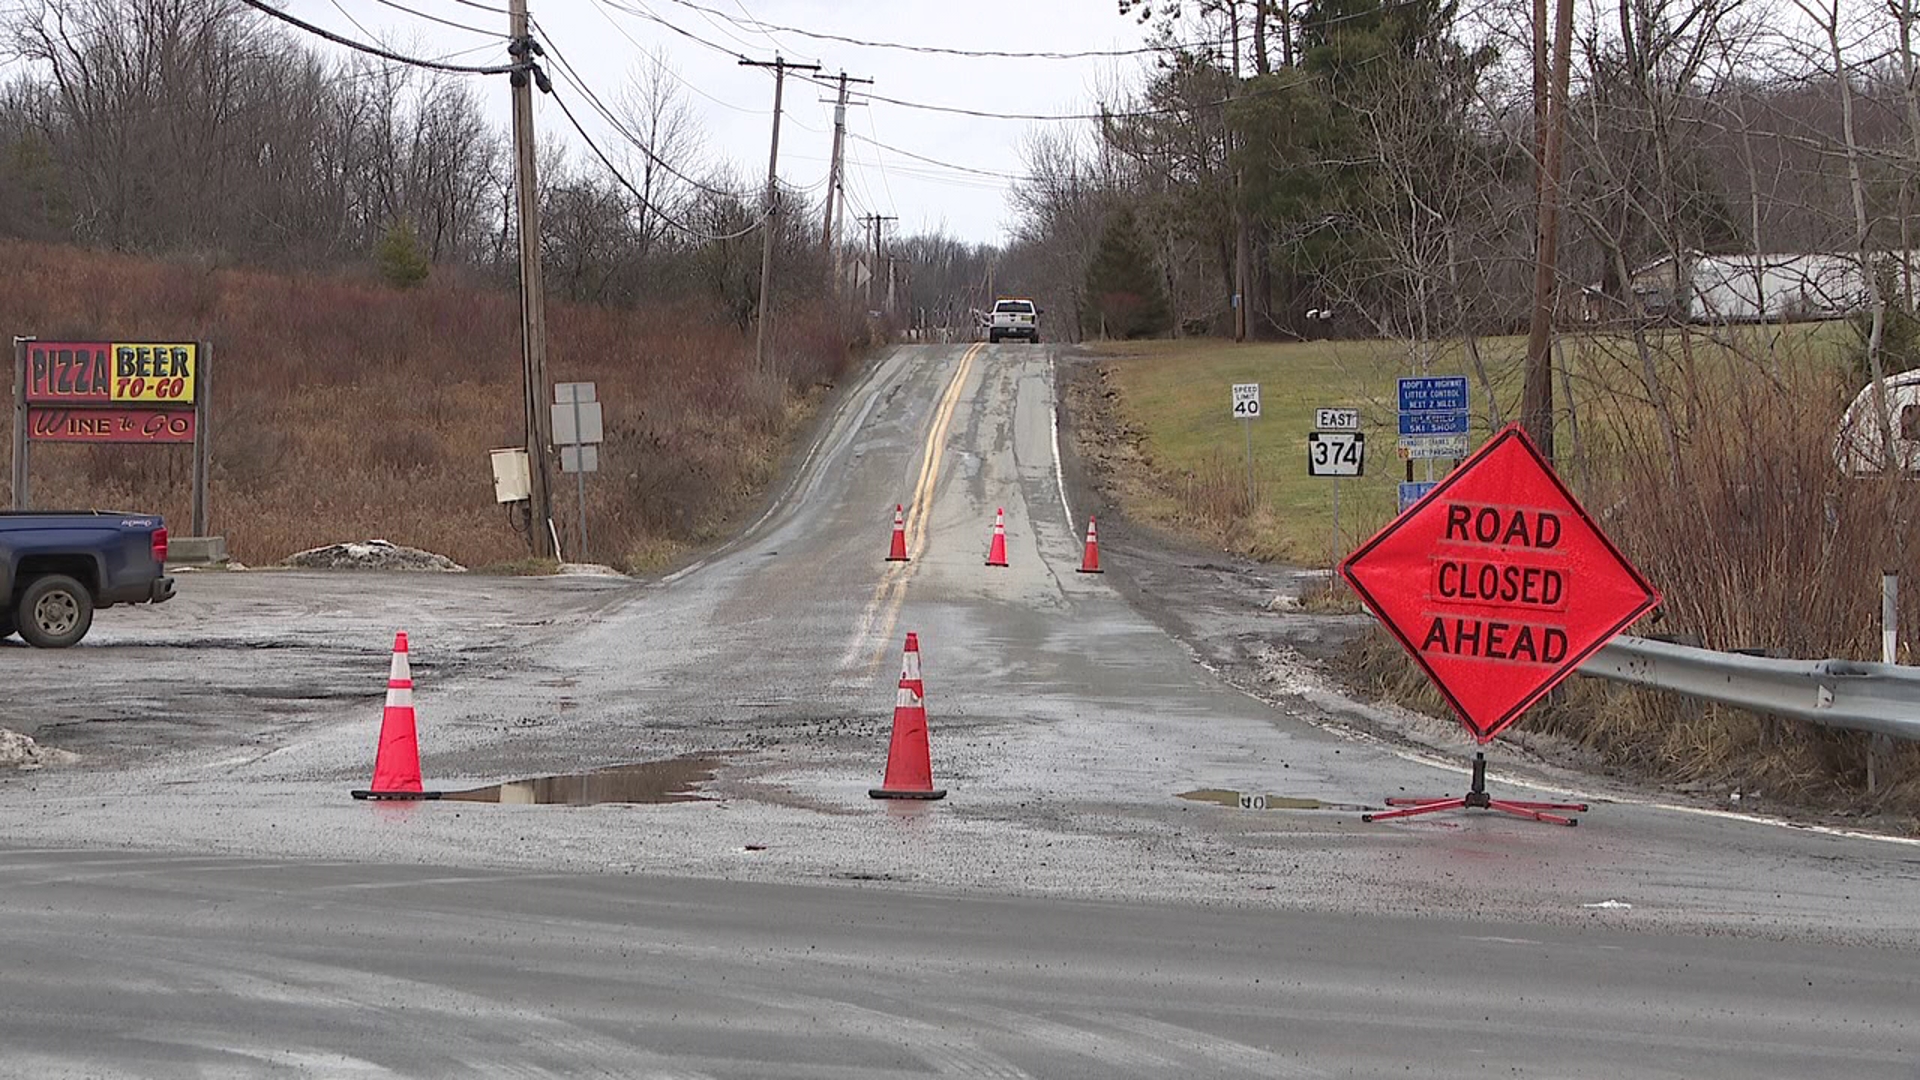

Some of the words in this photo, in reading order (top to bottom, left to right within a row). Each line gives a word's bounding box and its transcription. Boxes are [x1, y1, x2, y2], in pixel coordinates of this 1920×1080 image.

[32, 349, 108, 394] PIZZA
[117, 346, 190, 377] BEER
[117, 377, 184, 398] TO-GO
[1402, 380, 1423, 389] ADOPT
[1427, 380, 1433, 388] A
[1405, 390, 1428, 399] LITTER
[1430, 389, 1460, 398] CONTROL
[1235, 400, 1258, 414] 40
[1321, 411, 1352, 426] EAST
[1409, 424, 1426, 432] SKI
[1431, 422, 1457, 431] SHOP
[1315, 442, 1357, 465] 374
[1446, 504, 1561, 548] ROAD
[1439, 562, 1562, 604] CLOSED
[1421, 617, 1568, 663] AHEAD
